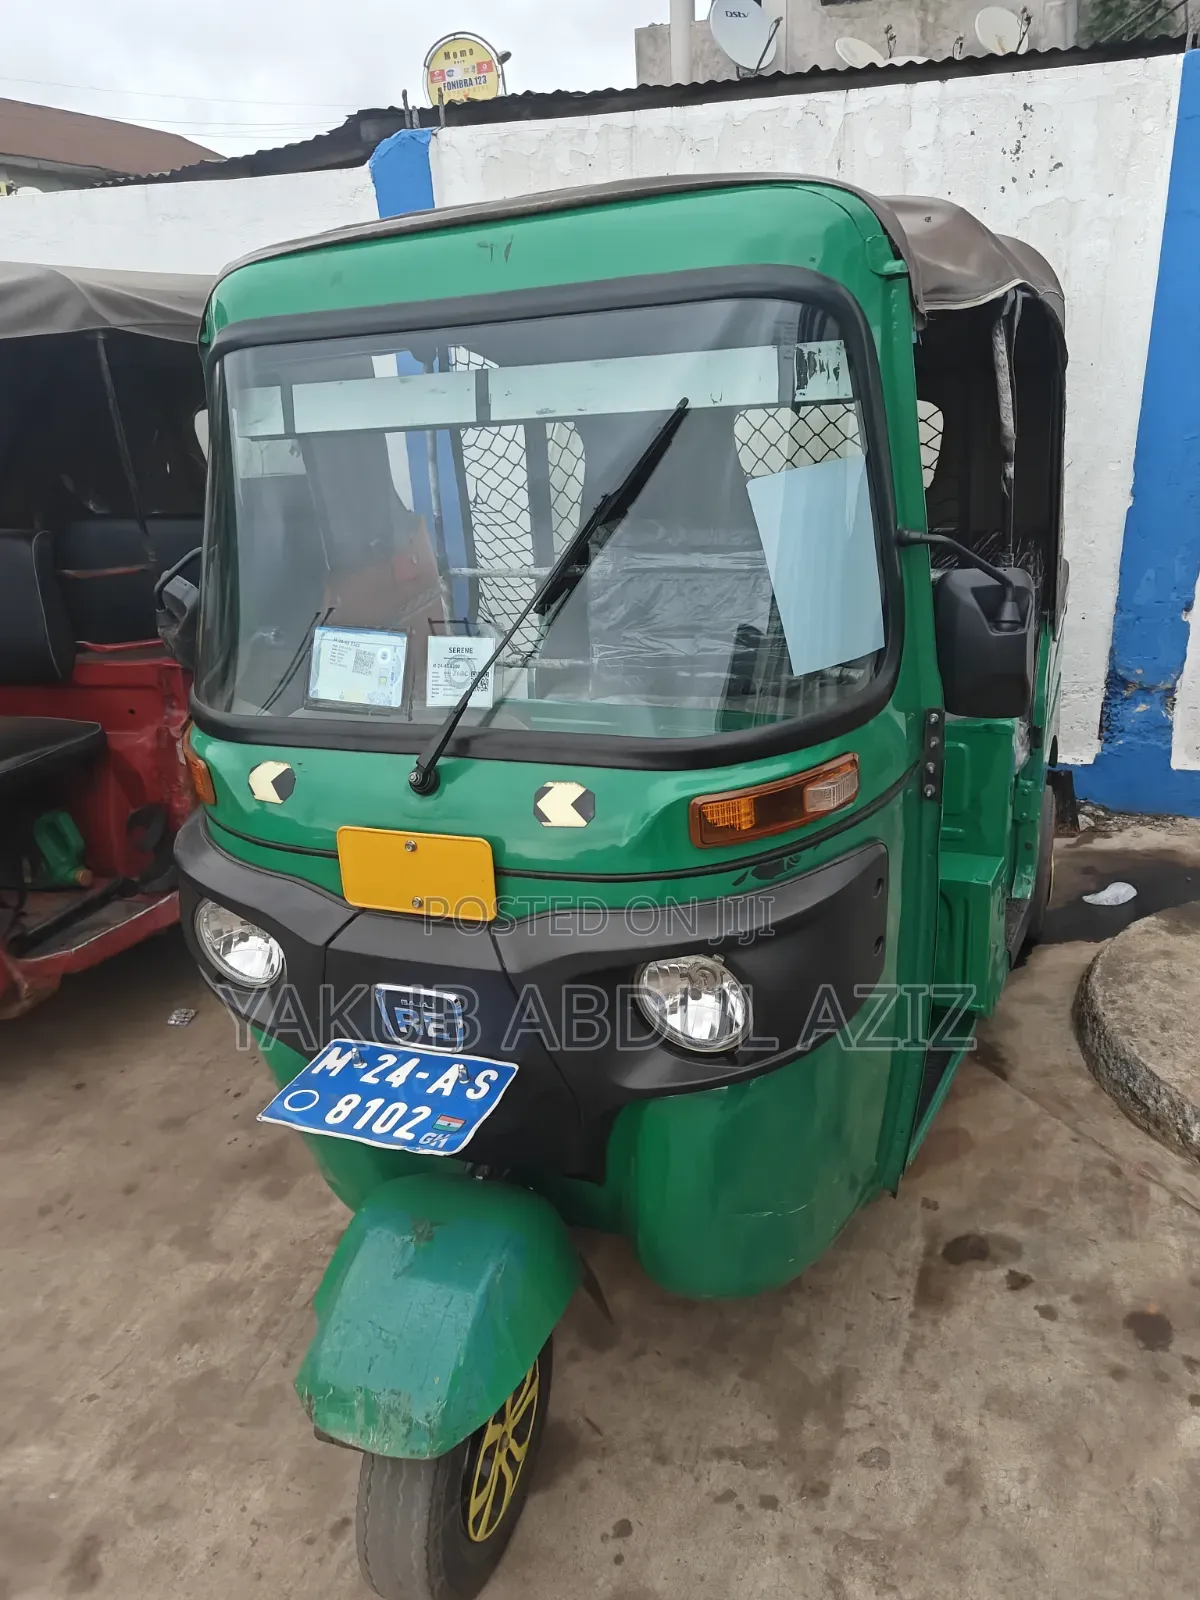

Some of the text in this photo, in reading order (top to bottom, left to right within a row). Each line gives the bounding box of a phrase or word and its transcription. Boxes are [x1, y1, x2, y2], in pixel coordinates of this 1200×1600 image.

[443, 75, 487, 91] FONIBRA 123
[394, 1006, 450, 1039] RE
[324, 1094, 432, 1141] 8102
[419, 1132, 451, 1148] GH
